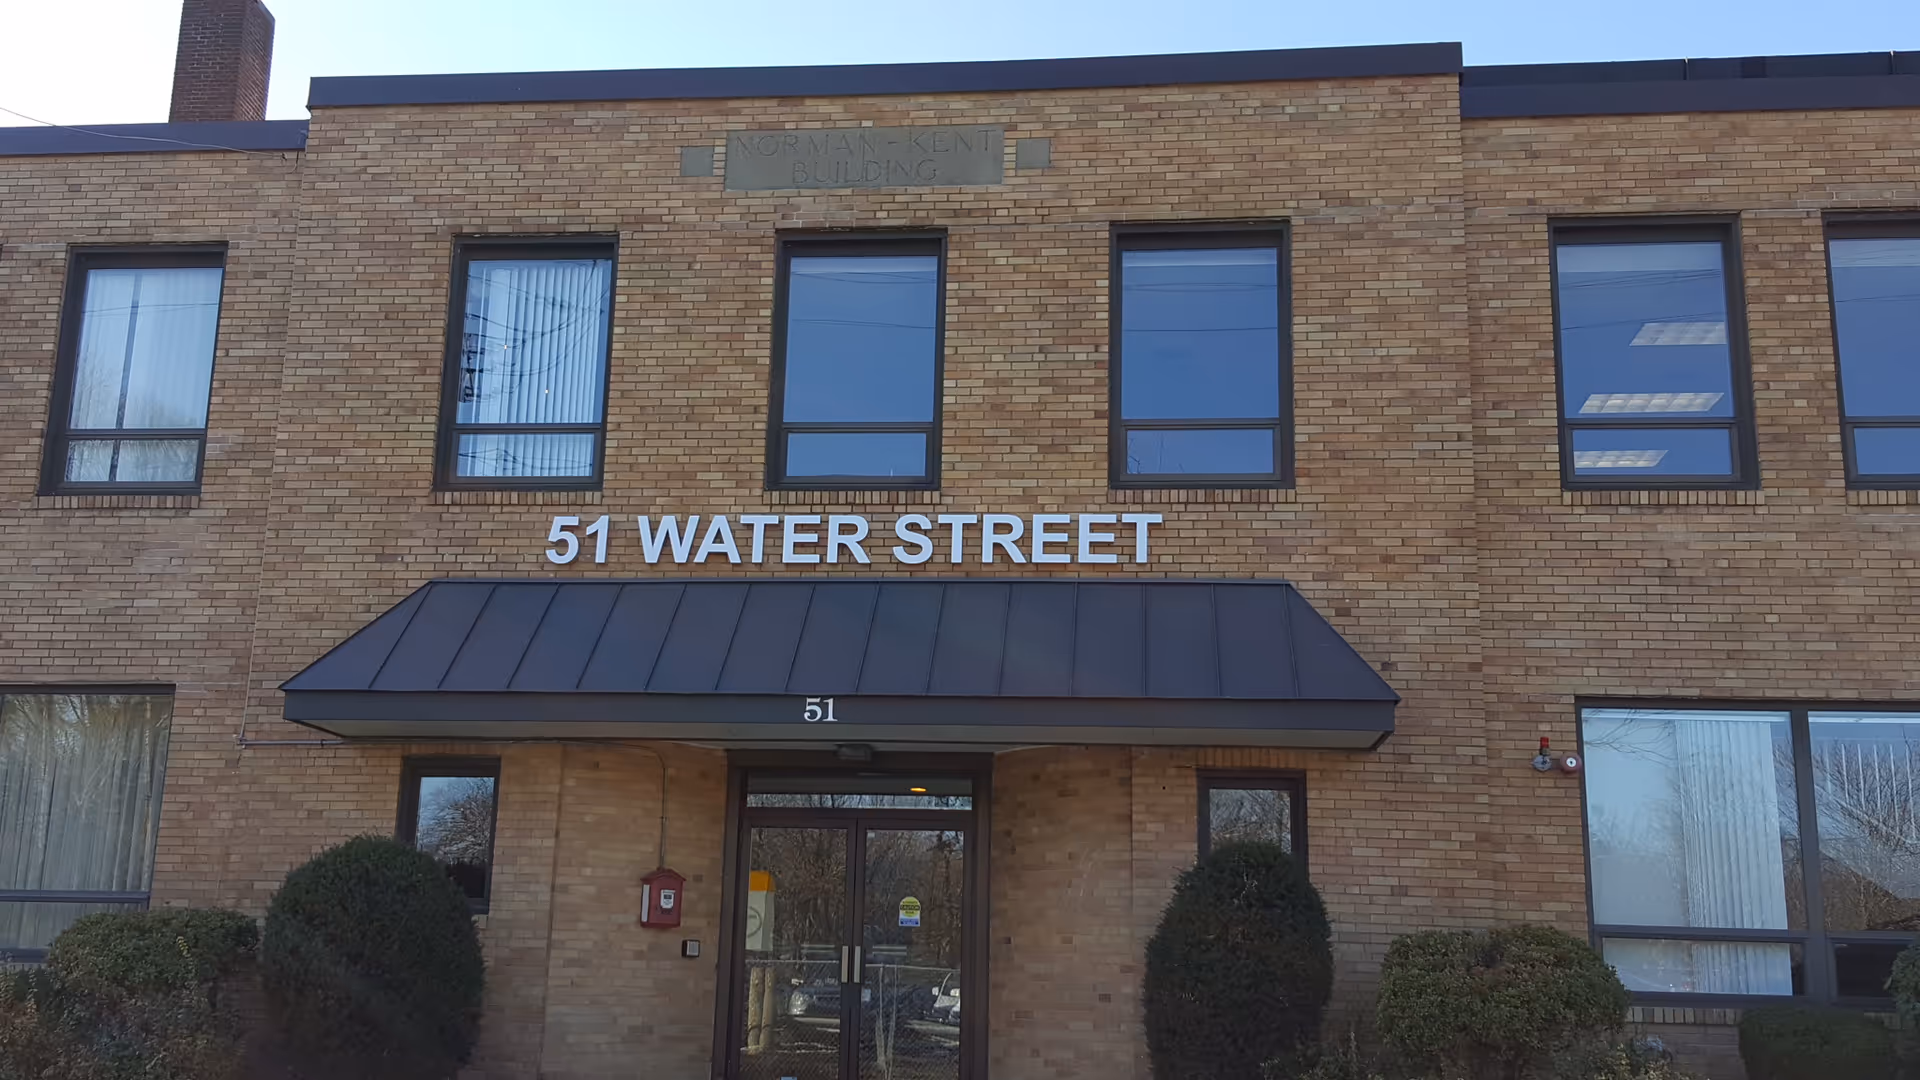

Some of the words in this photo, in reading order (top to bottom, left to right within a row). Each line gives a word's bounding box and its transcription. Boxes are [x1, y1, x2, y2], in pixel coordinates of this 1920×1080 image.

[792, 158, 937, 184] BUILDING
[545, 514, 610, 564] 51
[638, 514, 871, 564] WATER
[892, 513, 1163, 564] STREET
[803, 697, 838, 722] 51
